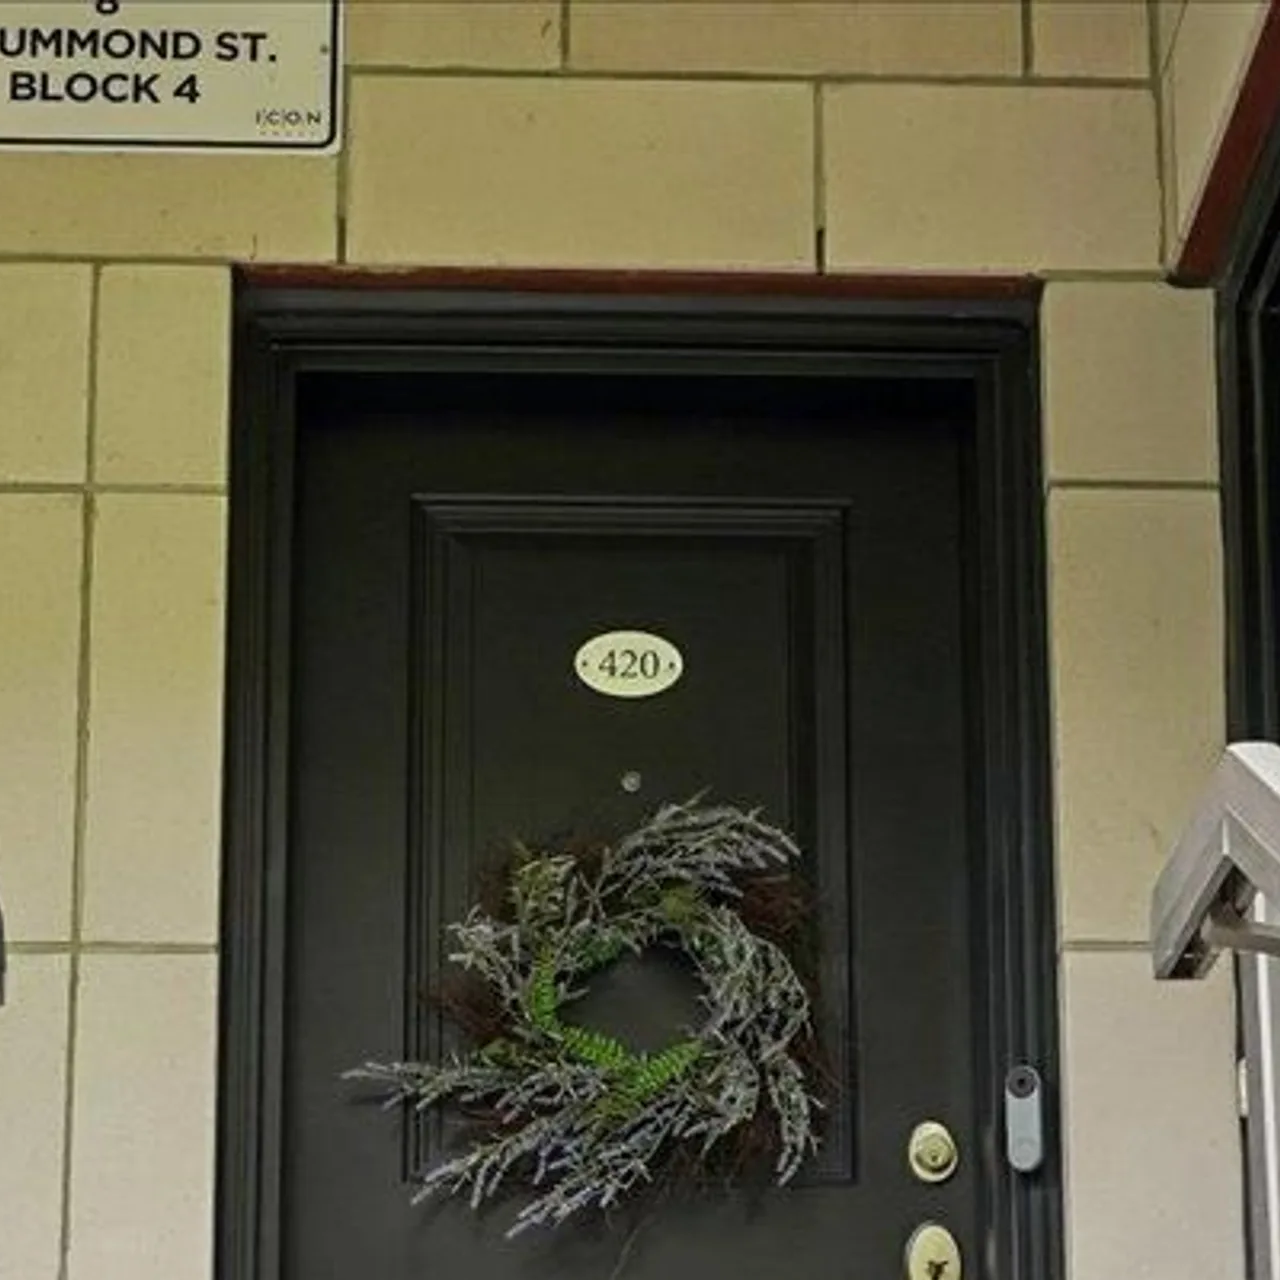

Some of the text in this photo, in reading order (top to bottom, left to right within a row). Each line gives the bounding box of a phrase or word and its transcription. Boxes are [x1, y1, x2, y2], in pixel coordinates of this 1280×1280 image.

[214, 31, 277, 62] ST.
[8, 71, 201, 104] BLOCK 4
[598, 648, 660, 679] 420
